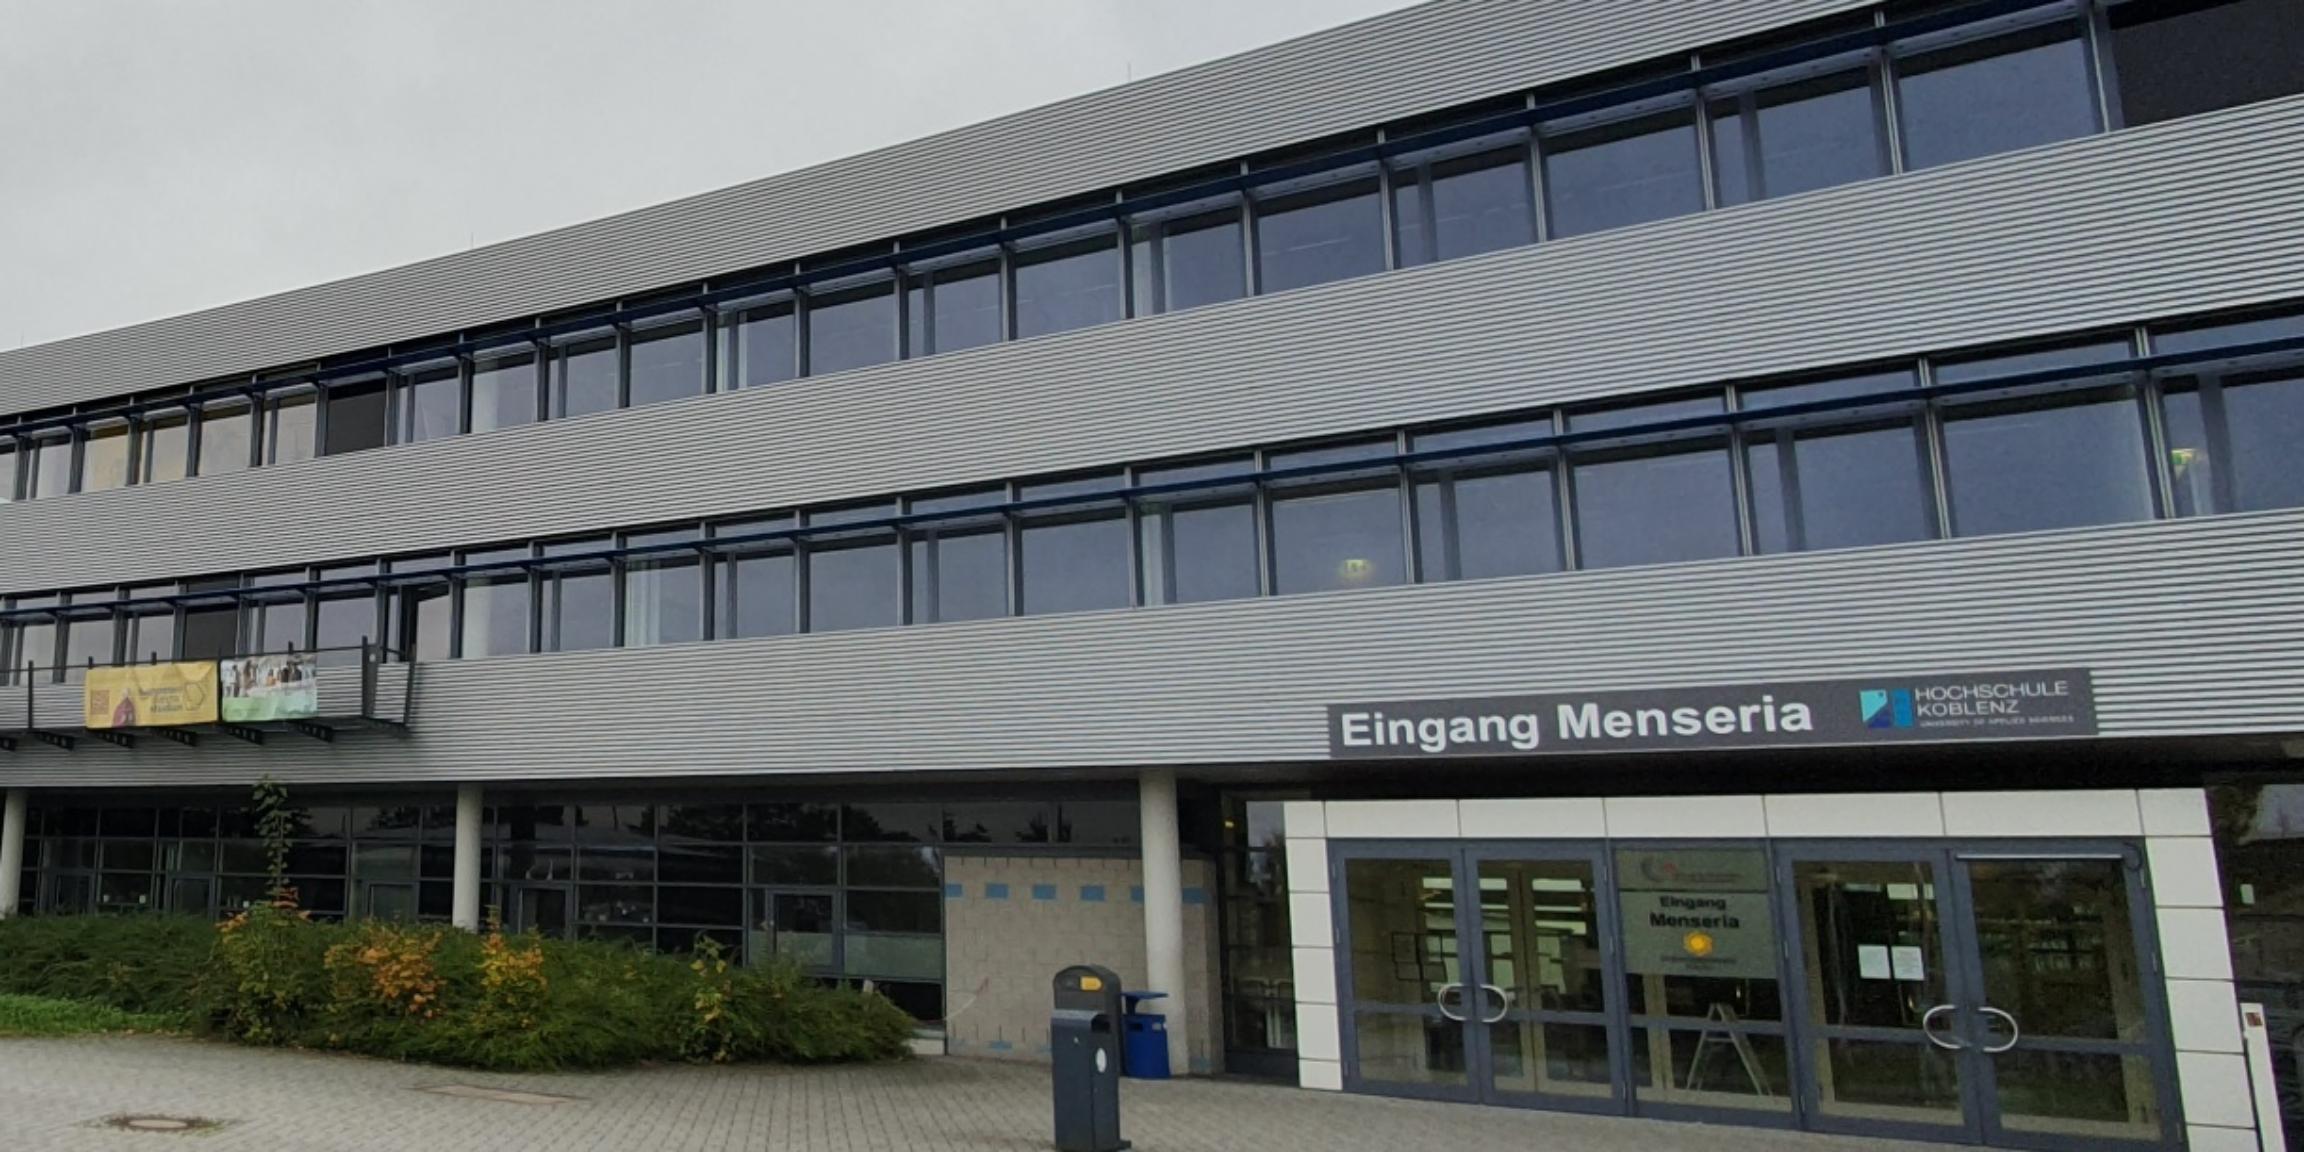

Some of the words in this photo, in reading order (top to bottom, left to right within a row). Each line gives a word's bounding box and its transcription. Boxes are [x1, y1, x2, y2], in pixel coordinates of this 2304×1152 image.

[1915, 680, 2069, 701] HOCHSCHULE
[1917, 699, 2021, 717] KOBLENZ
[1341, 711, 1540, 753] Eingang
[1556, 694, 1814, 740] Menseria
[1659, 895, 1727, 911] Eingang
[1649, 912, 1740, 929] Menseria
